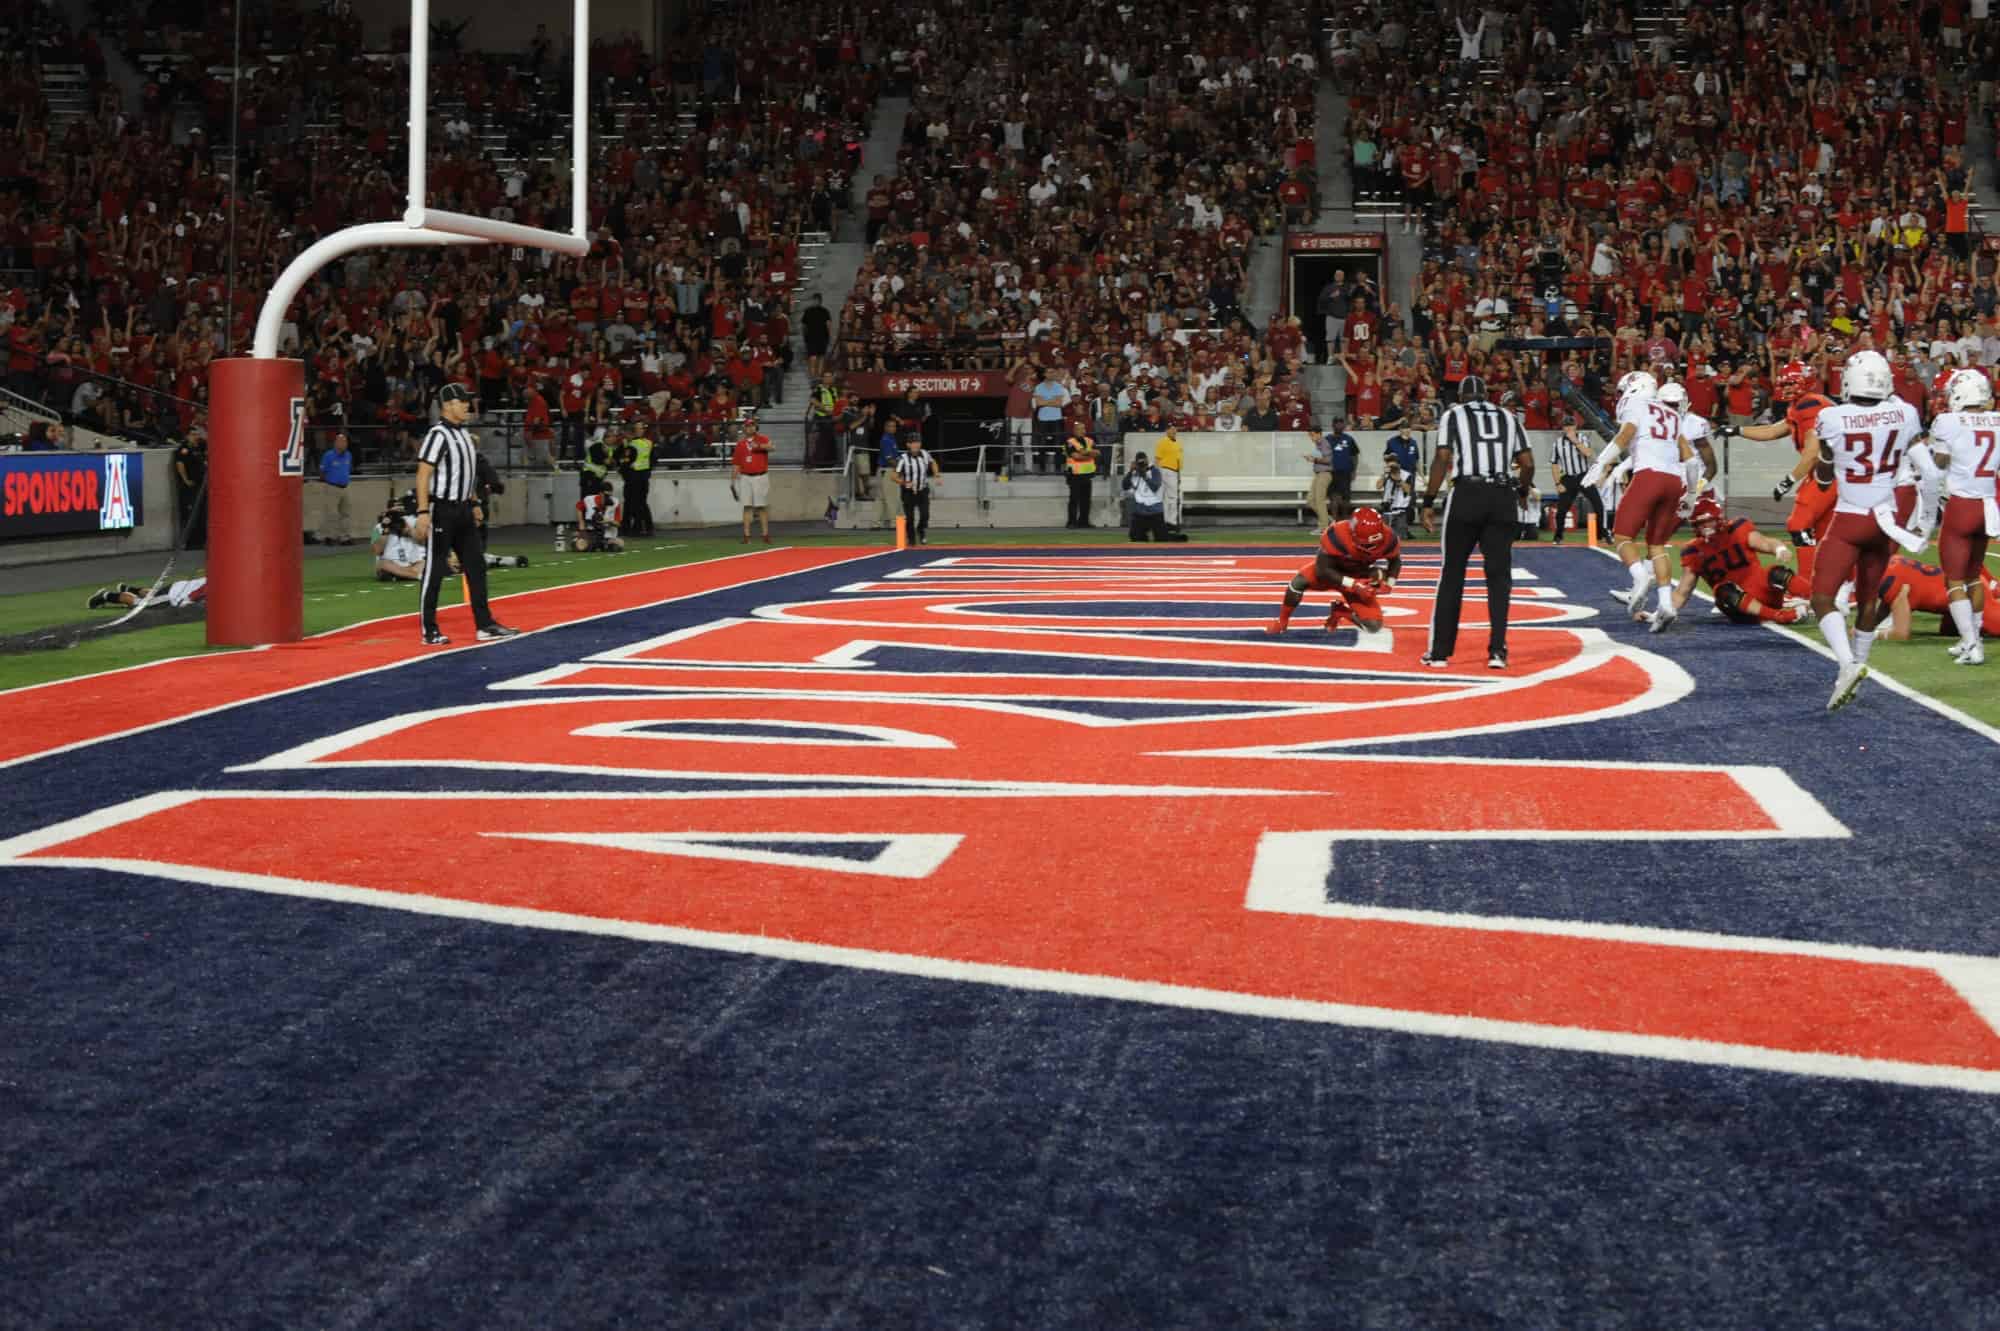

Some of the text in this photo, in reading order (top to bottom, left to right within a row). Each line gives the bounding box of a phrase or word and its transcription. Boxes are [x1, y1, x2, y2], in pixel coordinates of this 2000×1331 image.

[912, 378, 957, 392] SECTION
[959, 378, 969, 392] 17
[1472, 410, 1499, 439] U
[1648, 402, 1679, 440] 37
[1840, 409, 1905, 429] THOMPSON
[1843, 429, 1903, 484] 34
[1973, 430, 1996, 477] 2
[4, 469, 98, 516] SPONSOR
